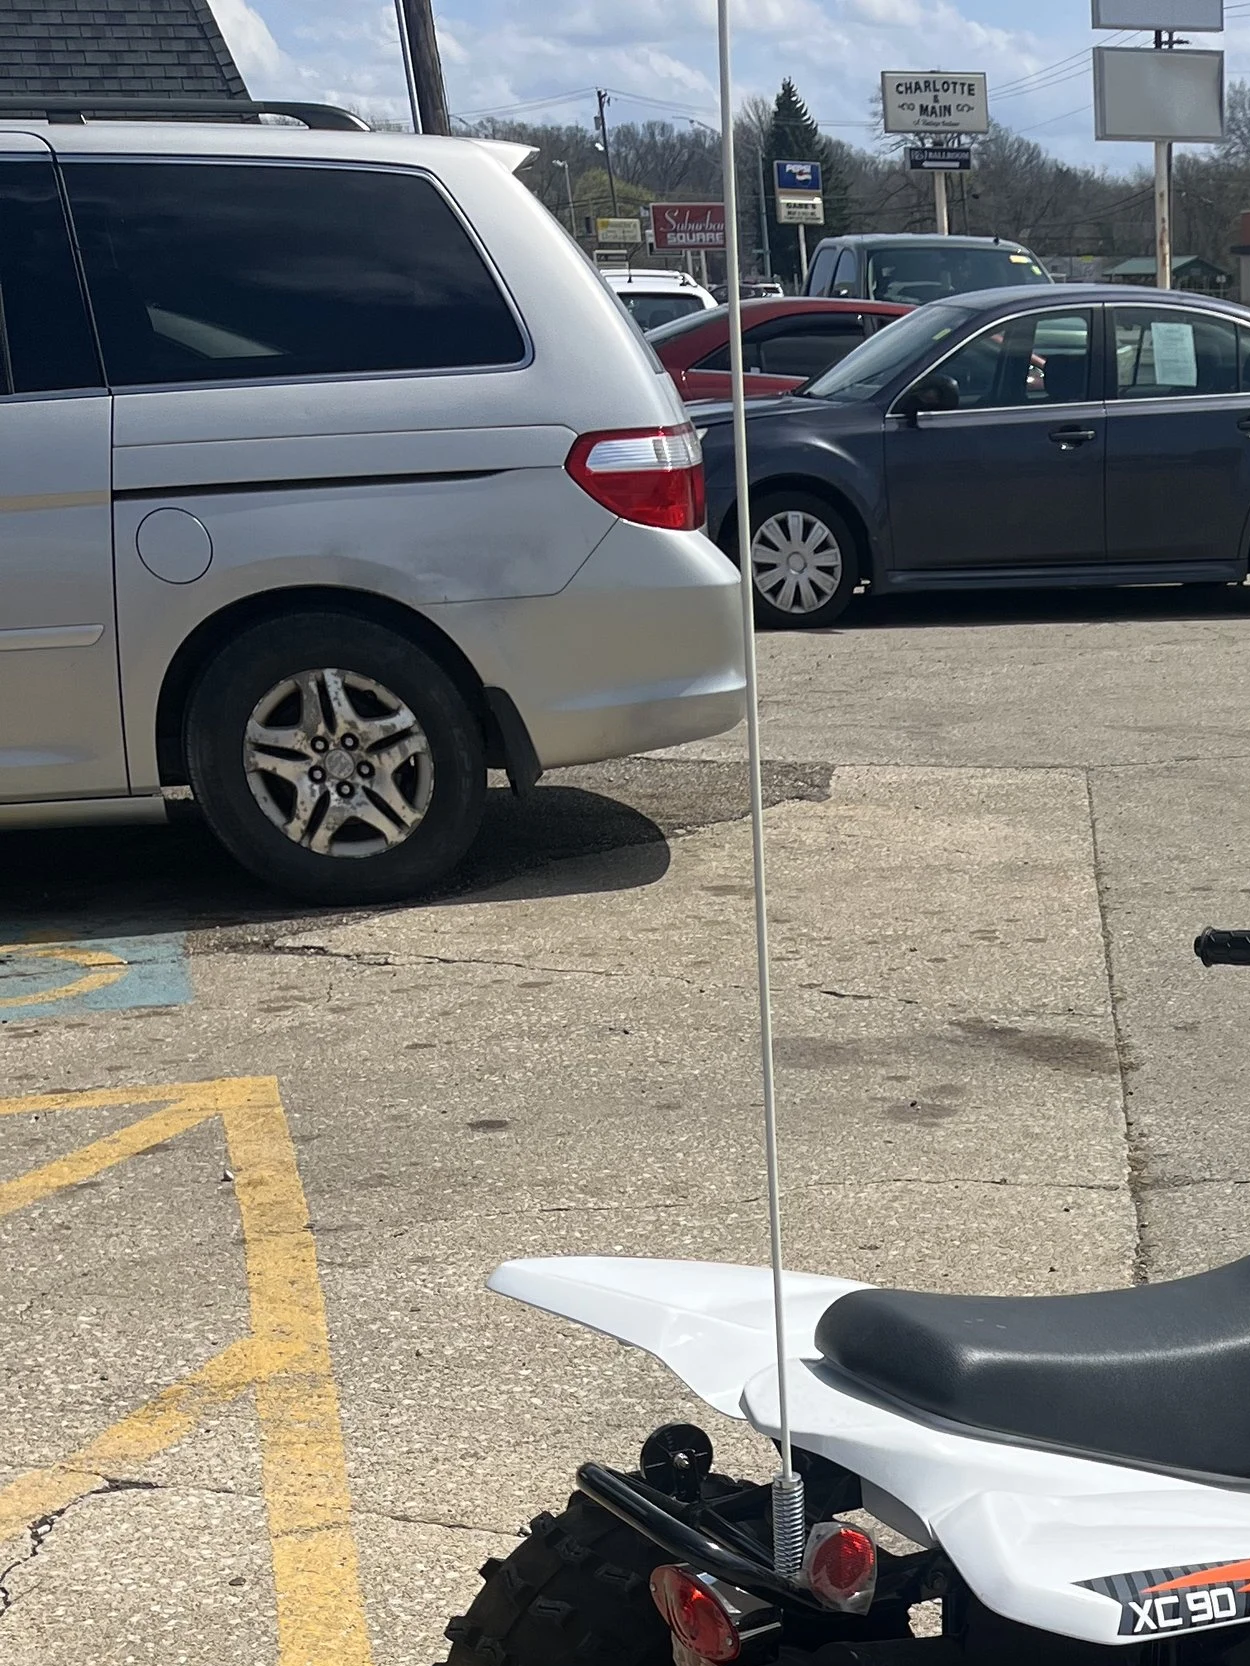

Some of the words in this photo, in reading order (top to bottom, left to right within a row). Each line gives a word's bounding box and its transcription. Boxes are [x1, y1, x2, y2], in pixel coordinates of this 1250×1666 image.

[895, 79, 976, 97] CHARLOTTE
[919, 103, 952, 118] MAIN
[667, 232, 725, 245] SQUARE
[1128, 1595, 1183, 1633] XC
[1186, 1587, 1237, 1623] 90
